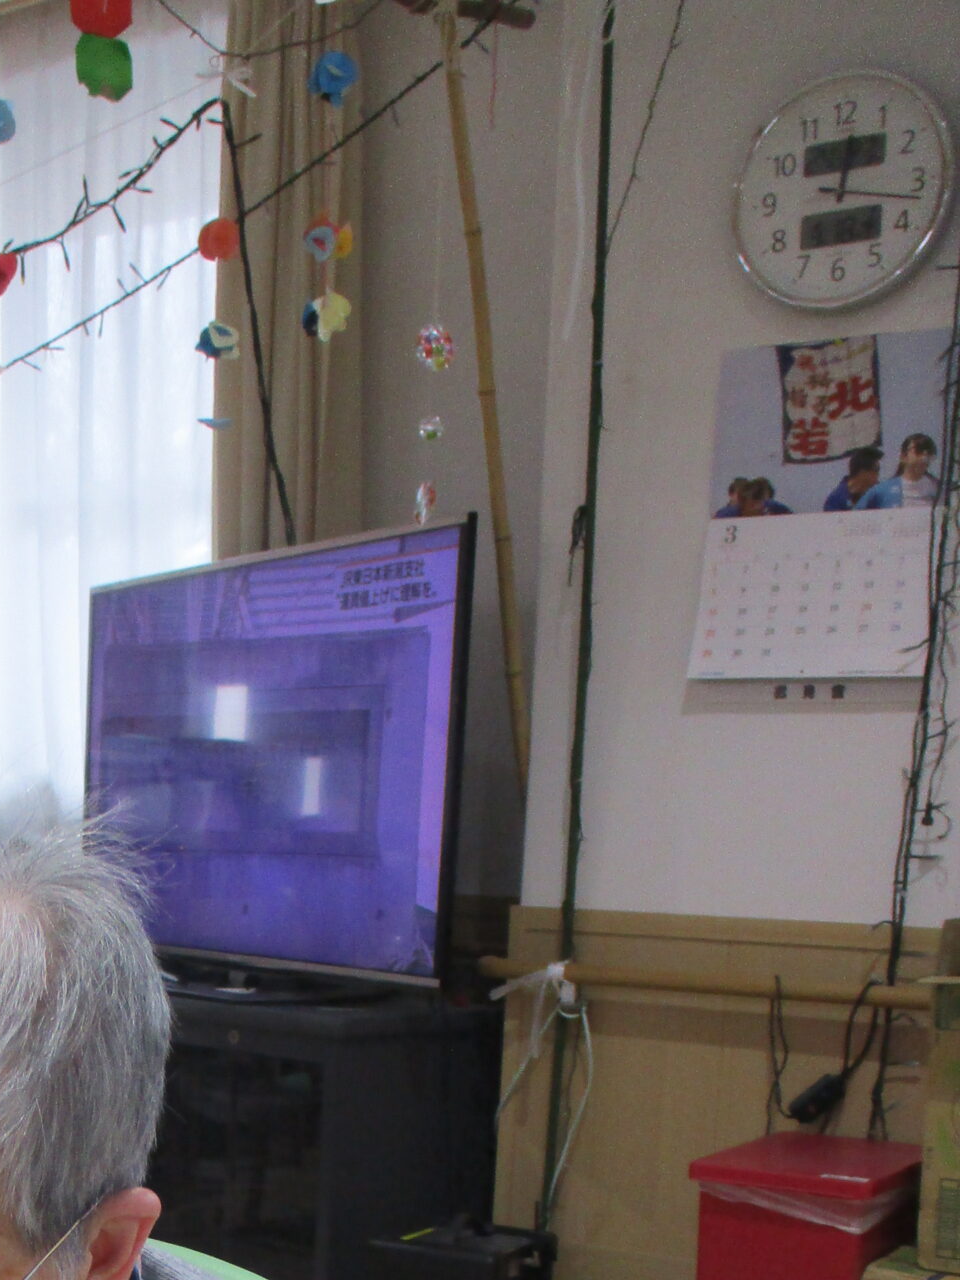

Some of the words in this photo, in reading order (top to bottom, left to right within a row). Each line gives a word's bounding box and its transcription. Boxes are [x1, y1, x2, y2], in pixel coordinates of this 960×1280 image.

[834, 101, 857, 125] 12
[878, 105, 887, 128] 1
[801, 118, 818, 140] 11
[900, 130, 916, 154] 2
[773, 153, 796, 177] 10
[911, 167, 925, 192] 3
[762, 192, 777, 217] 9
[893, 209, 909, 232] 4
[772, 229, 786, 253] 8
[797, 255, 810, 278] 7
[868, 243, 882, 267] 5
[831, 257, 845, 281] 6
[724, 525, 737, 544] 3
